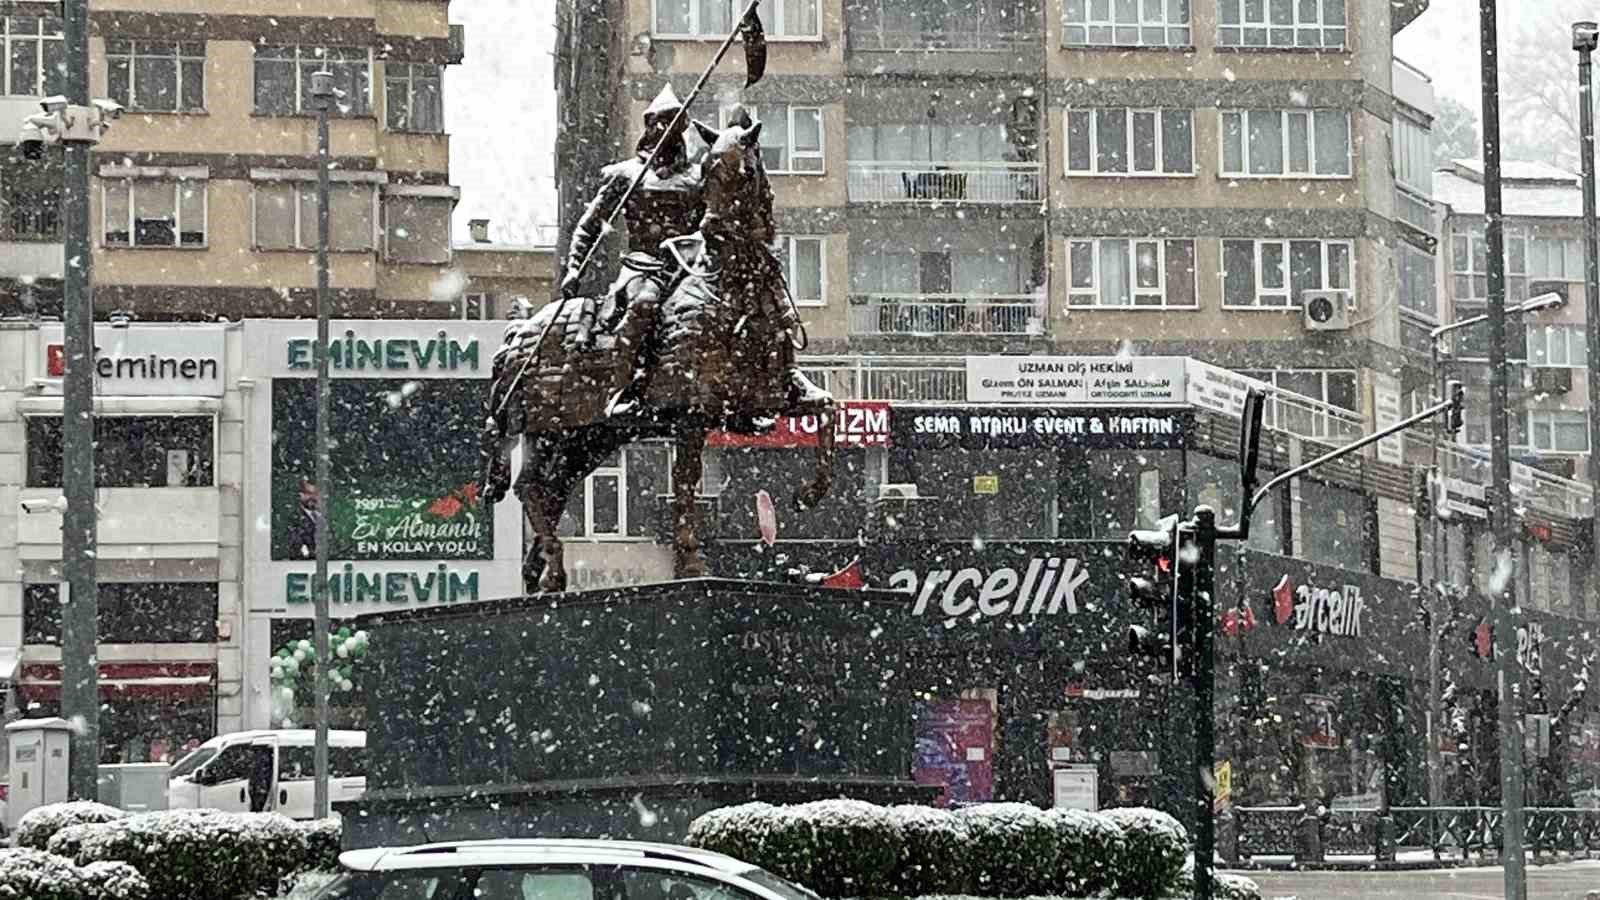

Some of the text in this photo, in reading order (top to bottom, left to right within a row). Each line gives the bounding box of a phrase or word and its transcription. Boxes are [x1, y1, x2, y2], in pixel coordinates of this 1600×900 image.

[287, 330, 479, 371] EMİNEVİM
[1018, 360, 1133, 376] UZMAN DİŞ HEKİMİ
[1017, 378, 1035, 388] ÖN
[913, 415, 960, 434] SEMA
[1033, 415, 1085, 434] EVENT
[1109, 416, 1173, 434] KAFTAN
[358, 541, 478, 555] EN KOLAY YOLU
[286, 564, 479, 604] EMİNEVİM
